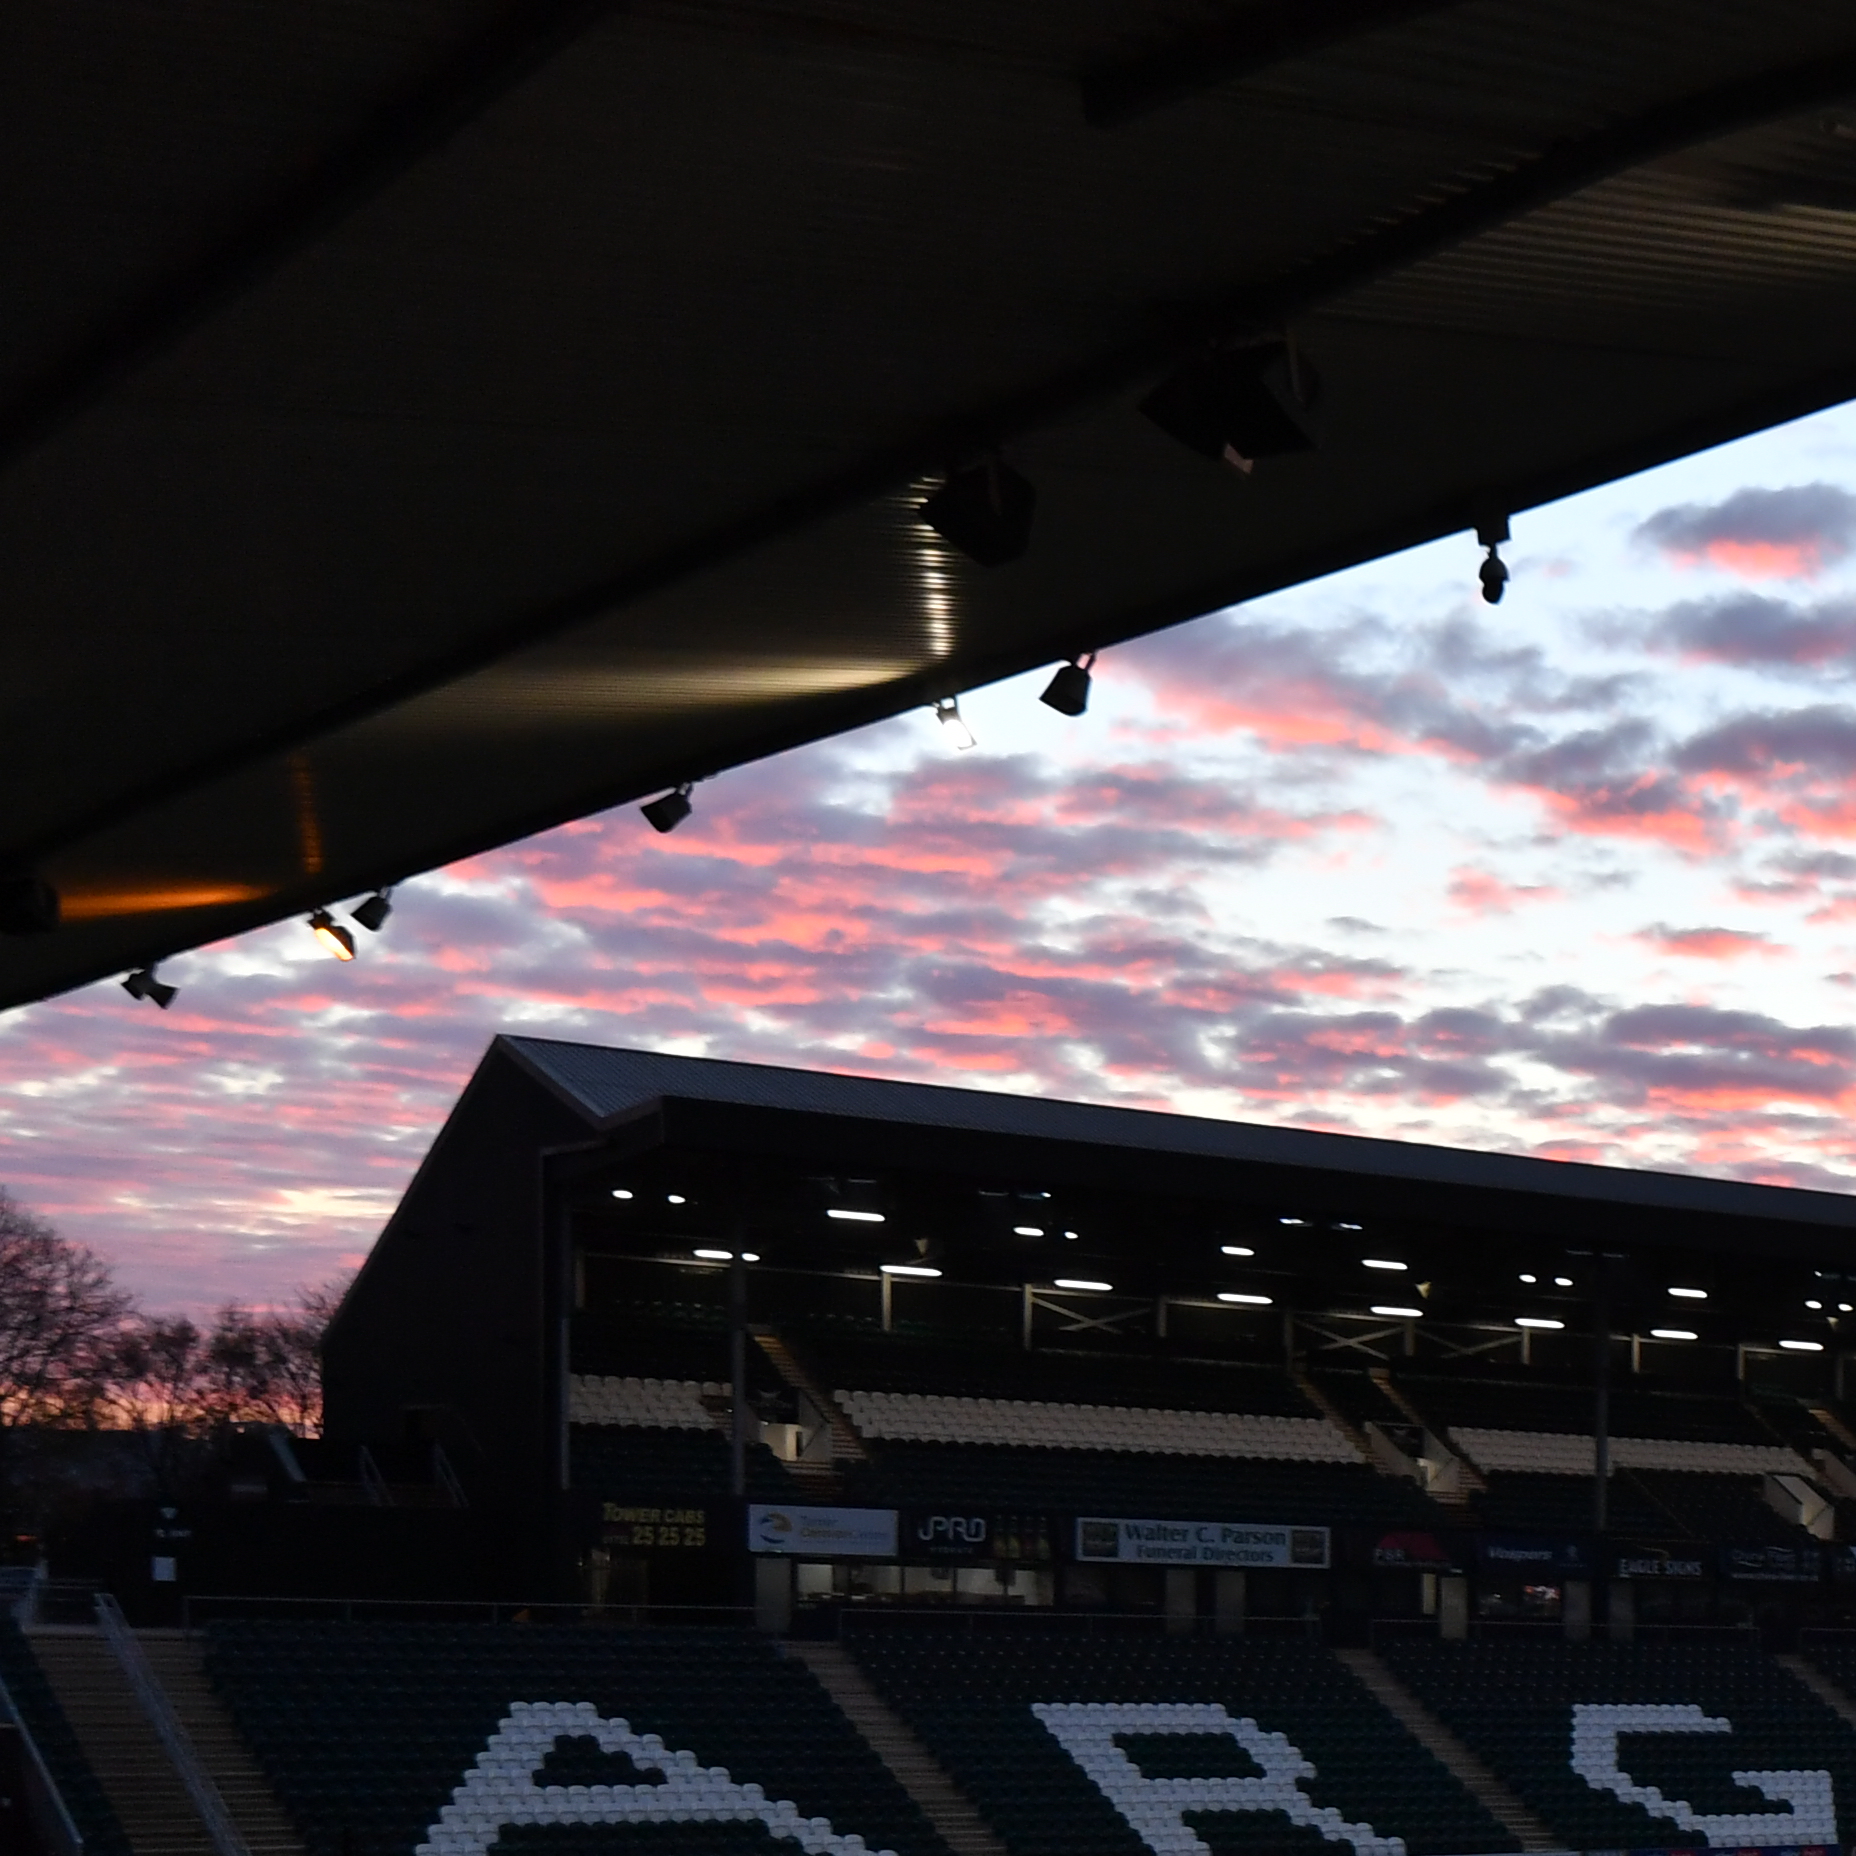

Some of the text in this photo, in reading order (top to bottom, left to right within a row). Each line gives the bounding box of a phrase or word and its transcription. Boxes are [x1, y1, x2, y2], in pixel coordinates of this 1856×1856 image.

[602, 1502, 706, 1523] TOWER CABS
[632, 1527, 655, 1546] 25
[658, 1527, 680, 1546] 25
[683, 1527, 706, 1546] 25
[1124, 1523, 1287, 1545] Walter C. Parson
[1135, 1544, 1274, 1562] Funeral Directors
